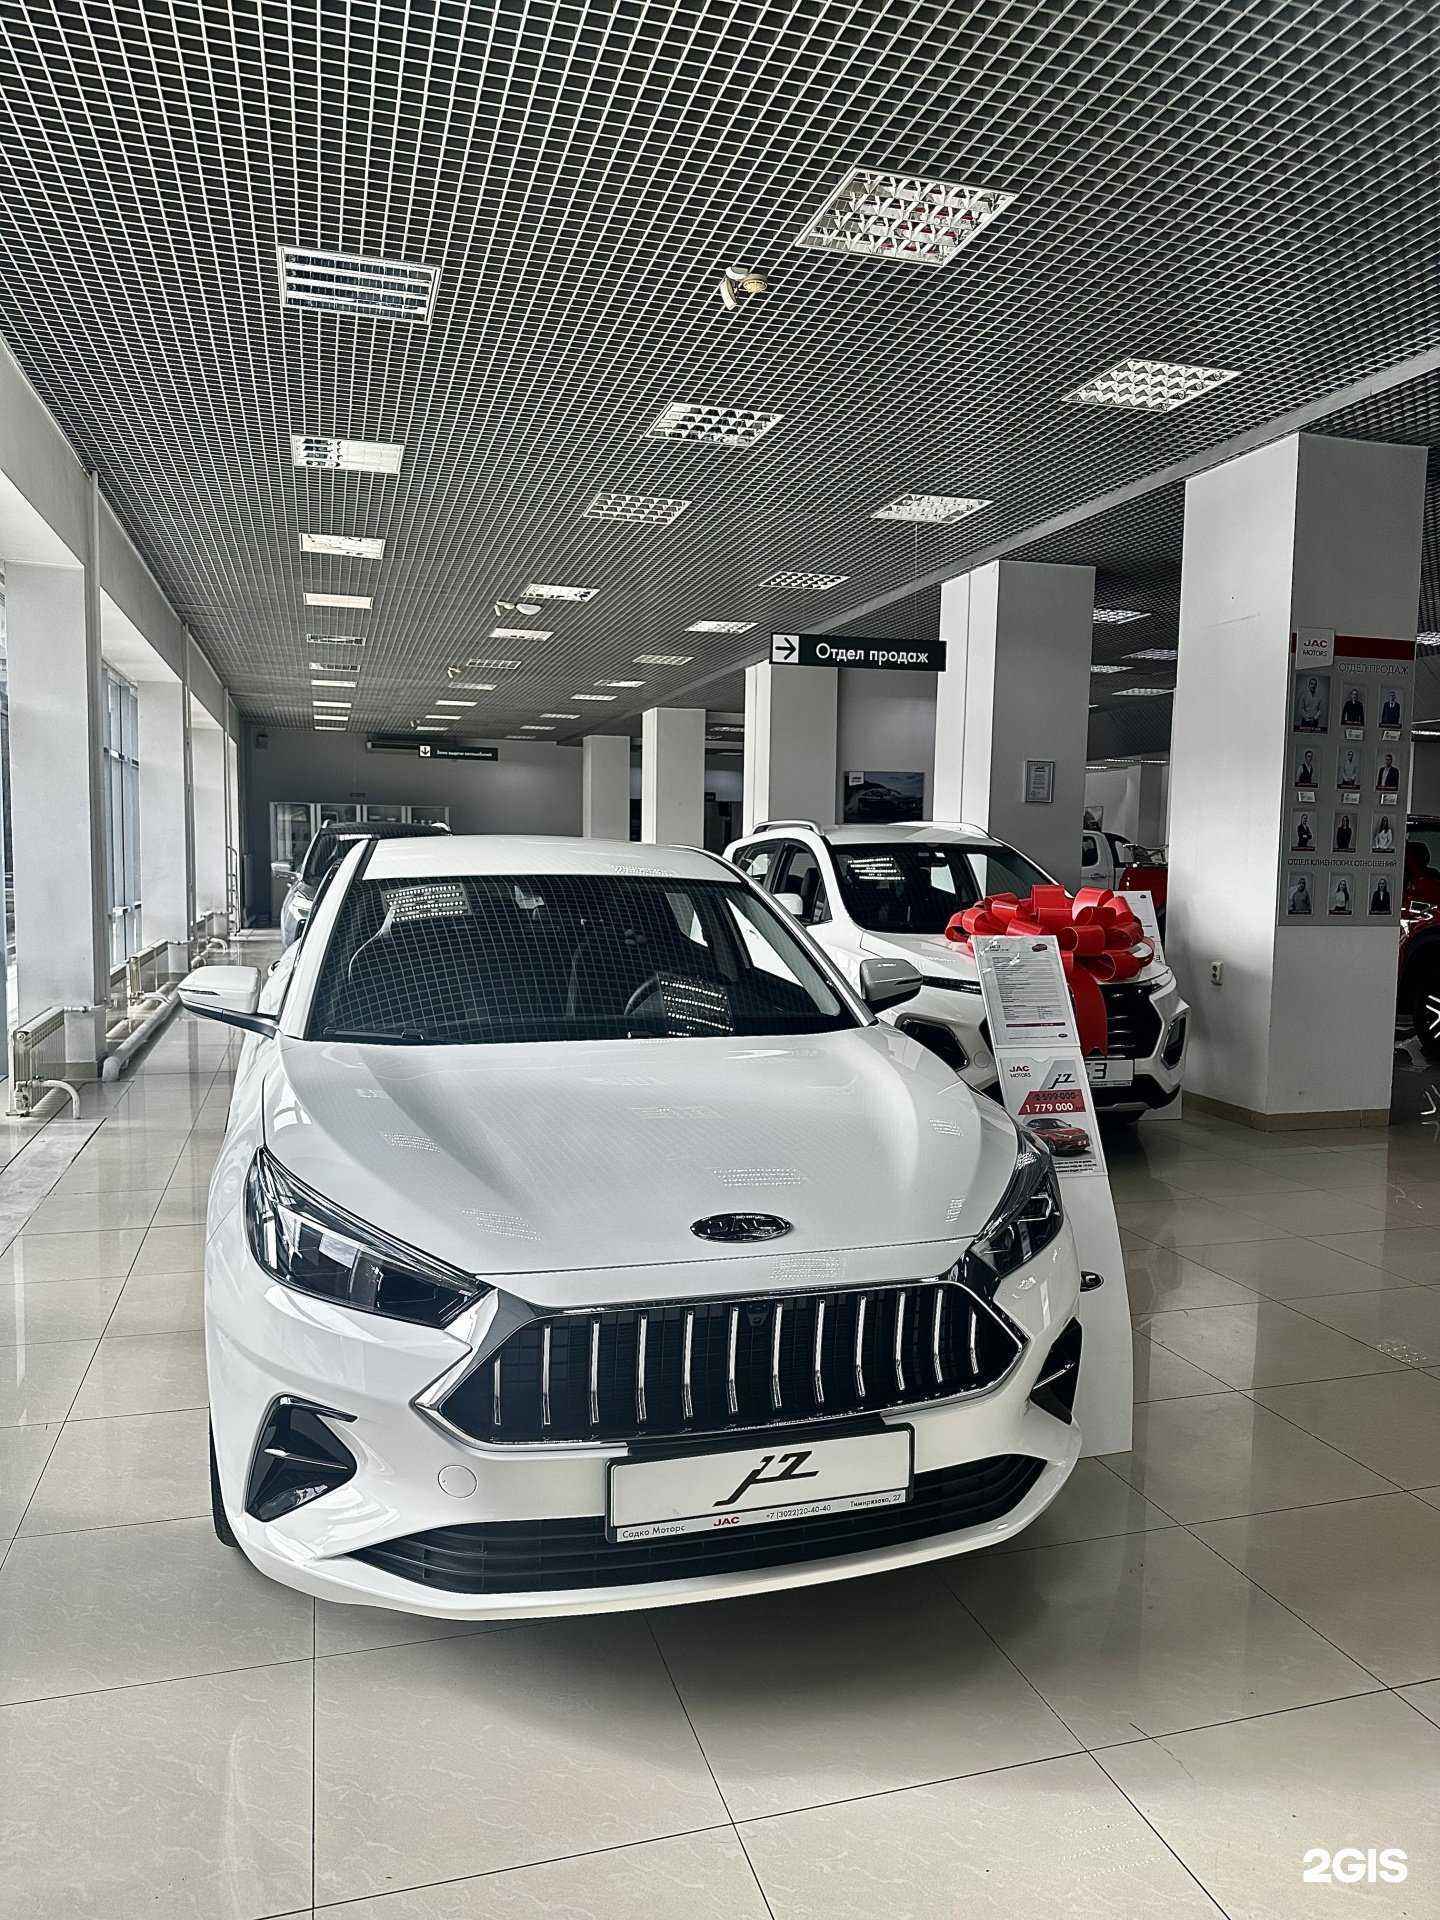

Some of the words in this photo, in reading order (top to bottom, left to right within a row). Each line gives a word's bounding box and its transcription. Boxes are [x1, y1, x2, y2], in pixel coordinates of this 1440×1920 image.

[1303, 639, 1328, 648] JAC
[815, 643, 864, 660] Отдел
[869, 649, 929, 665] продаж
[1302, 649, 1328, 657] MOTORS
[1009, 1065, 1030, 1073] JAC
[1025, 1104, 1031, 1113] 1
[1034, 1103, 1053, 1112] 779
[1055, 1102, 1074, 1111] 000
[713, 1516, 740, 1527] JAC
[652, 1525, 686, 1536] Моторс
